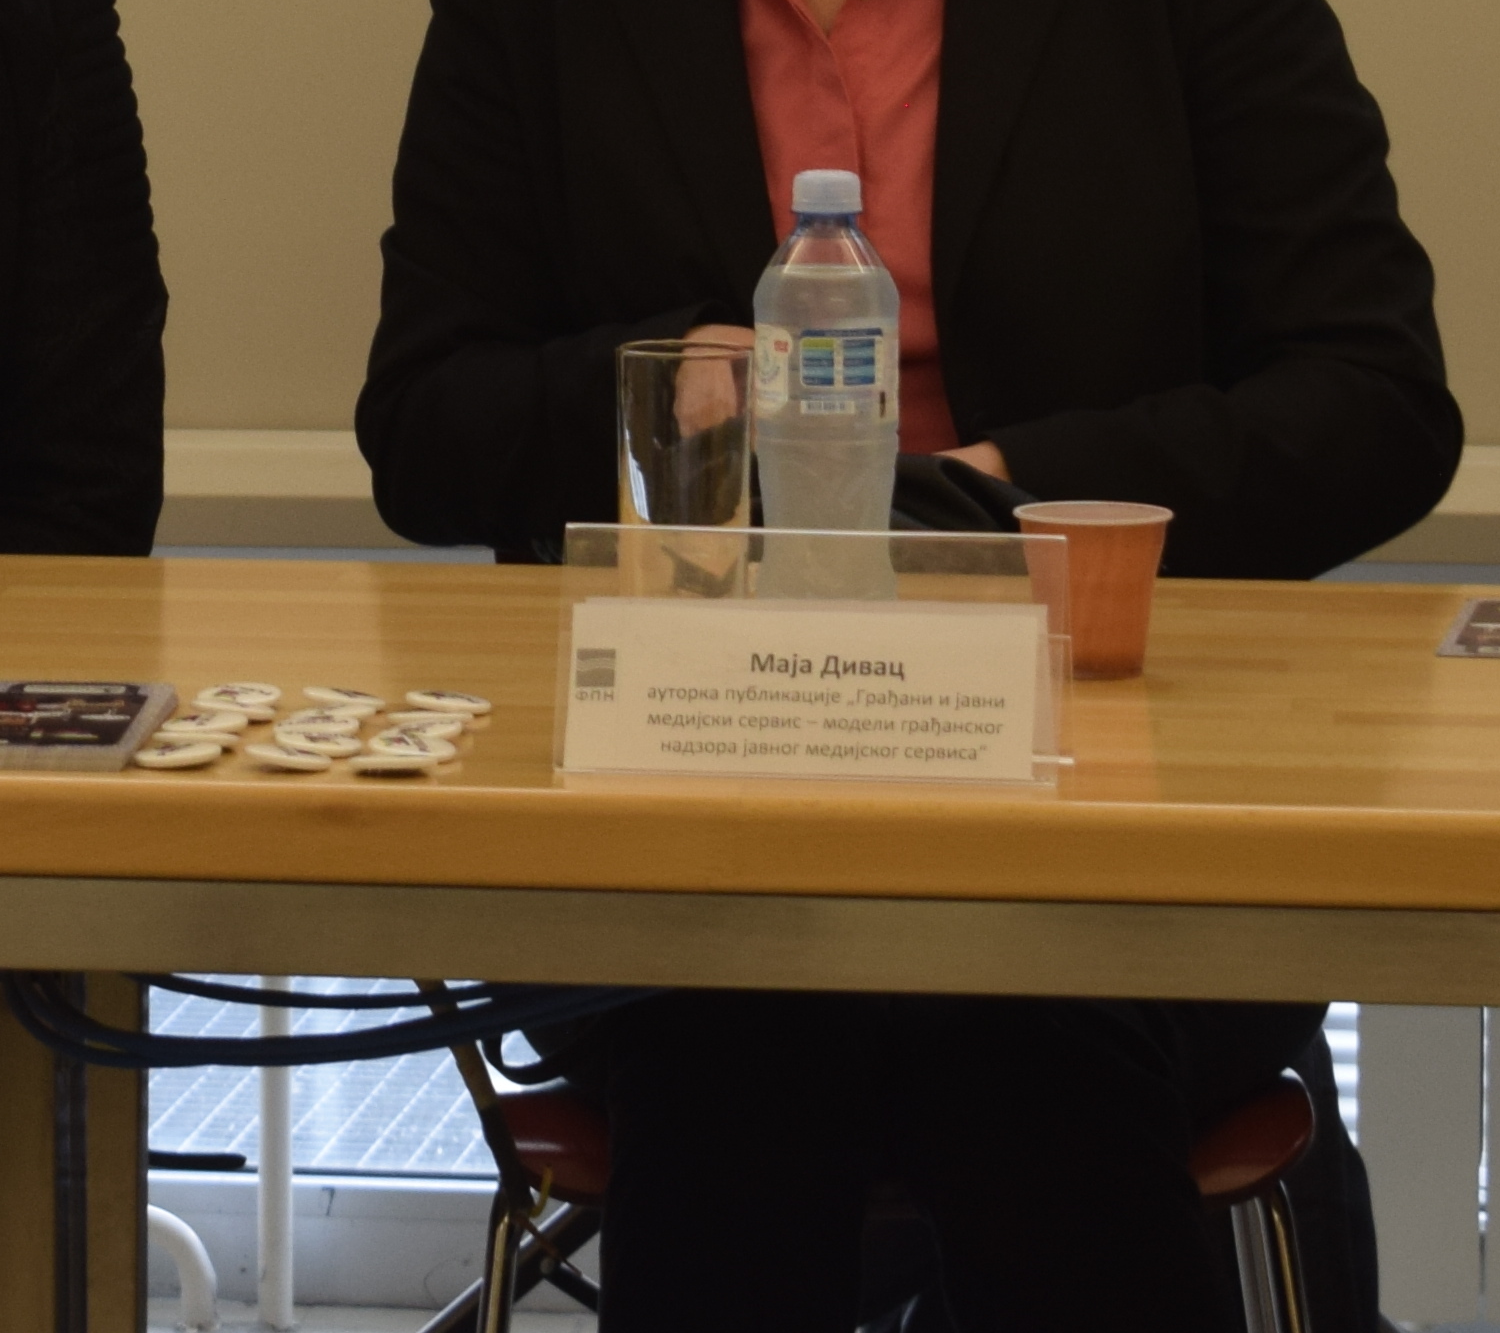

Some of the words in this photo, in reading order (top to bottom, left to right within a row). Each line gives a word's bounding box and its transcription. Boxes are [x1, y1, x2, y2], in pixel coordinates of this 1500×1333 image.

[750, 653, 812, 680] Маја
[820, 655, 906, 682] Дивац
[575, 688, 614, 702] ФПН
[647, 687, 718, 706] ауторка
[724, 687, 841, 709] публикације
[847, 688, 933, 711] „Грађани
[939, 695, 950, 706] и
[954, 693, 1005, 712] јавни
[646, 712, 733, 731] медијски
[739, 715, 801, 732] сервис
[823, 717, 895, 734] модели
[900, 717, 1004, 737] грађанског
[660, 739, 736, 758] надзора
[742, 739, 800, 760] јавног
[805, 742, 898, 763] медијског
[904, 744, 988, 765] сервиса“
